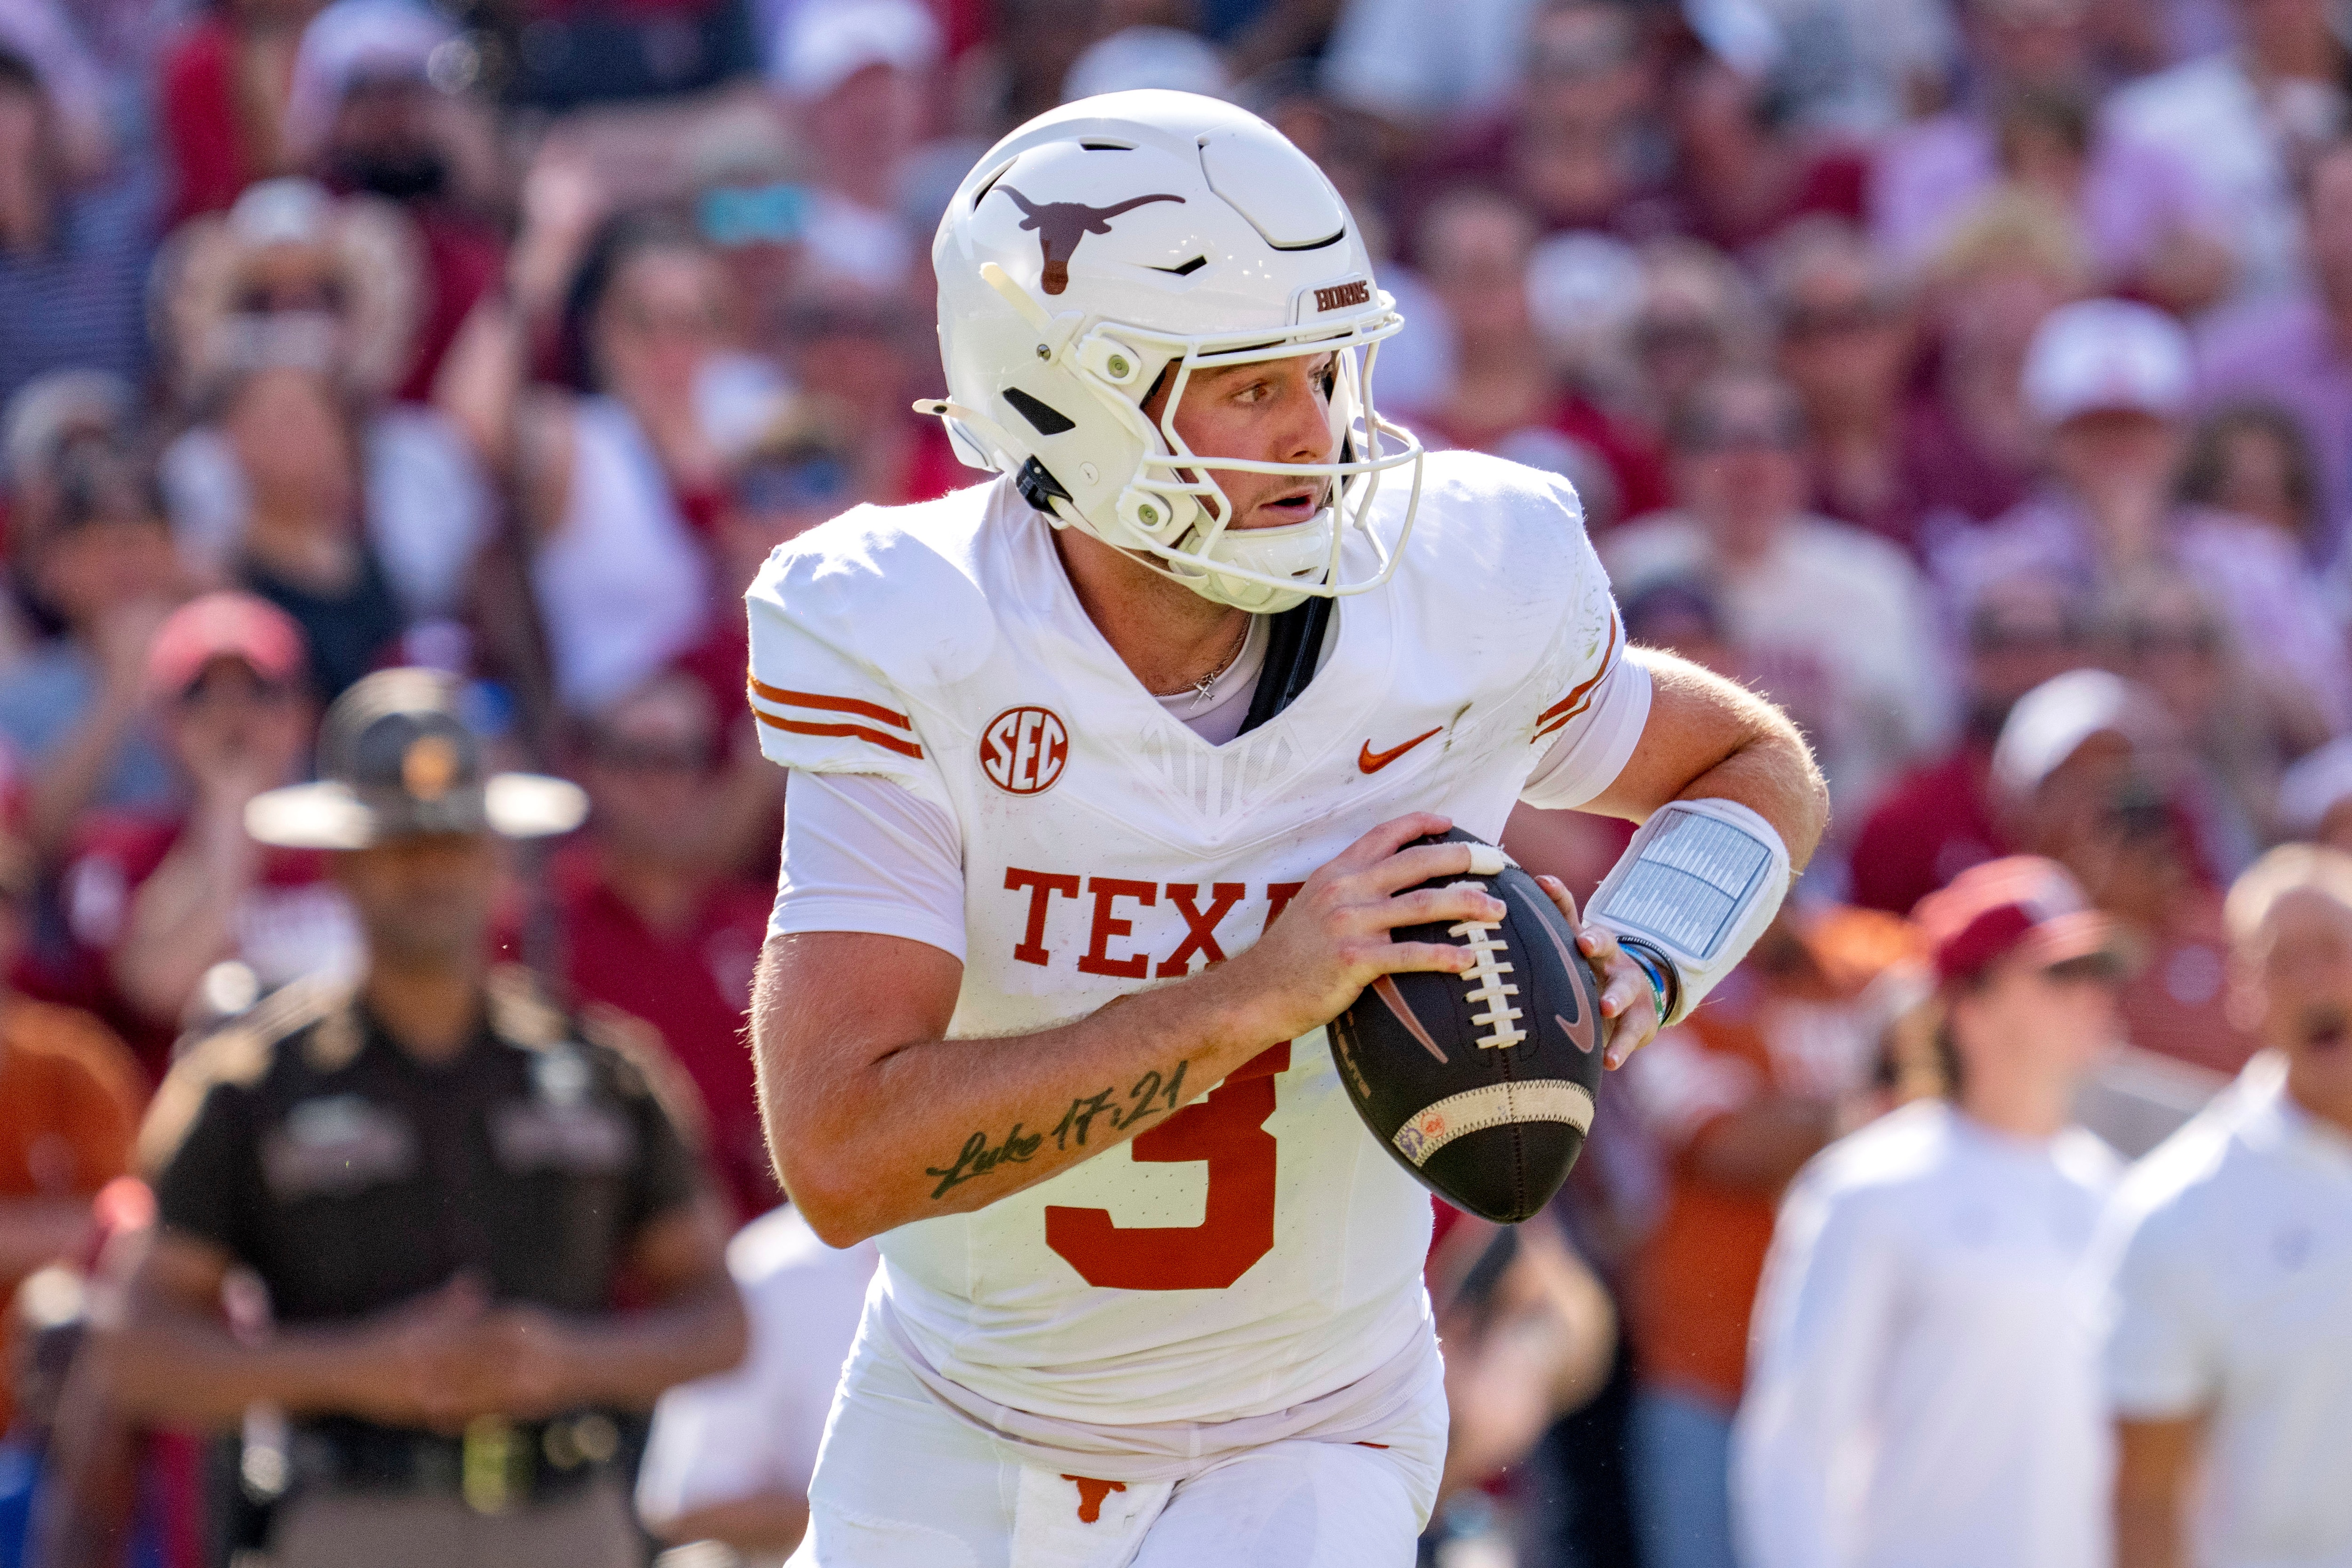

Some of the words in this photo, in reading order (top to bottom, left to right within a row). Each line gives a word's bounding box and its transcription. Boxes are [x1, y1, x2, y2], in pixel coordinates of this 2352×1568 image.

[1314, 280, 1370, 312] HORNS
[985, 710, 1065, 789] SEC
[926, 1122, 1043, 1200] Luke
[1045, 1039, 1292, 1291] 3
